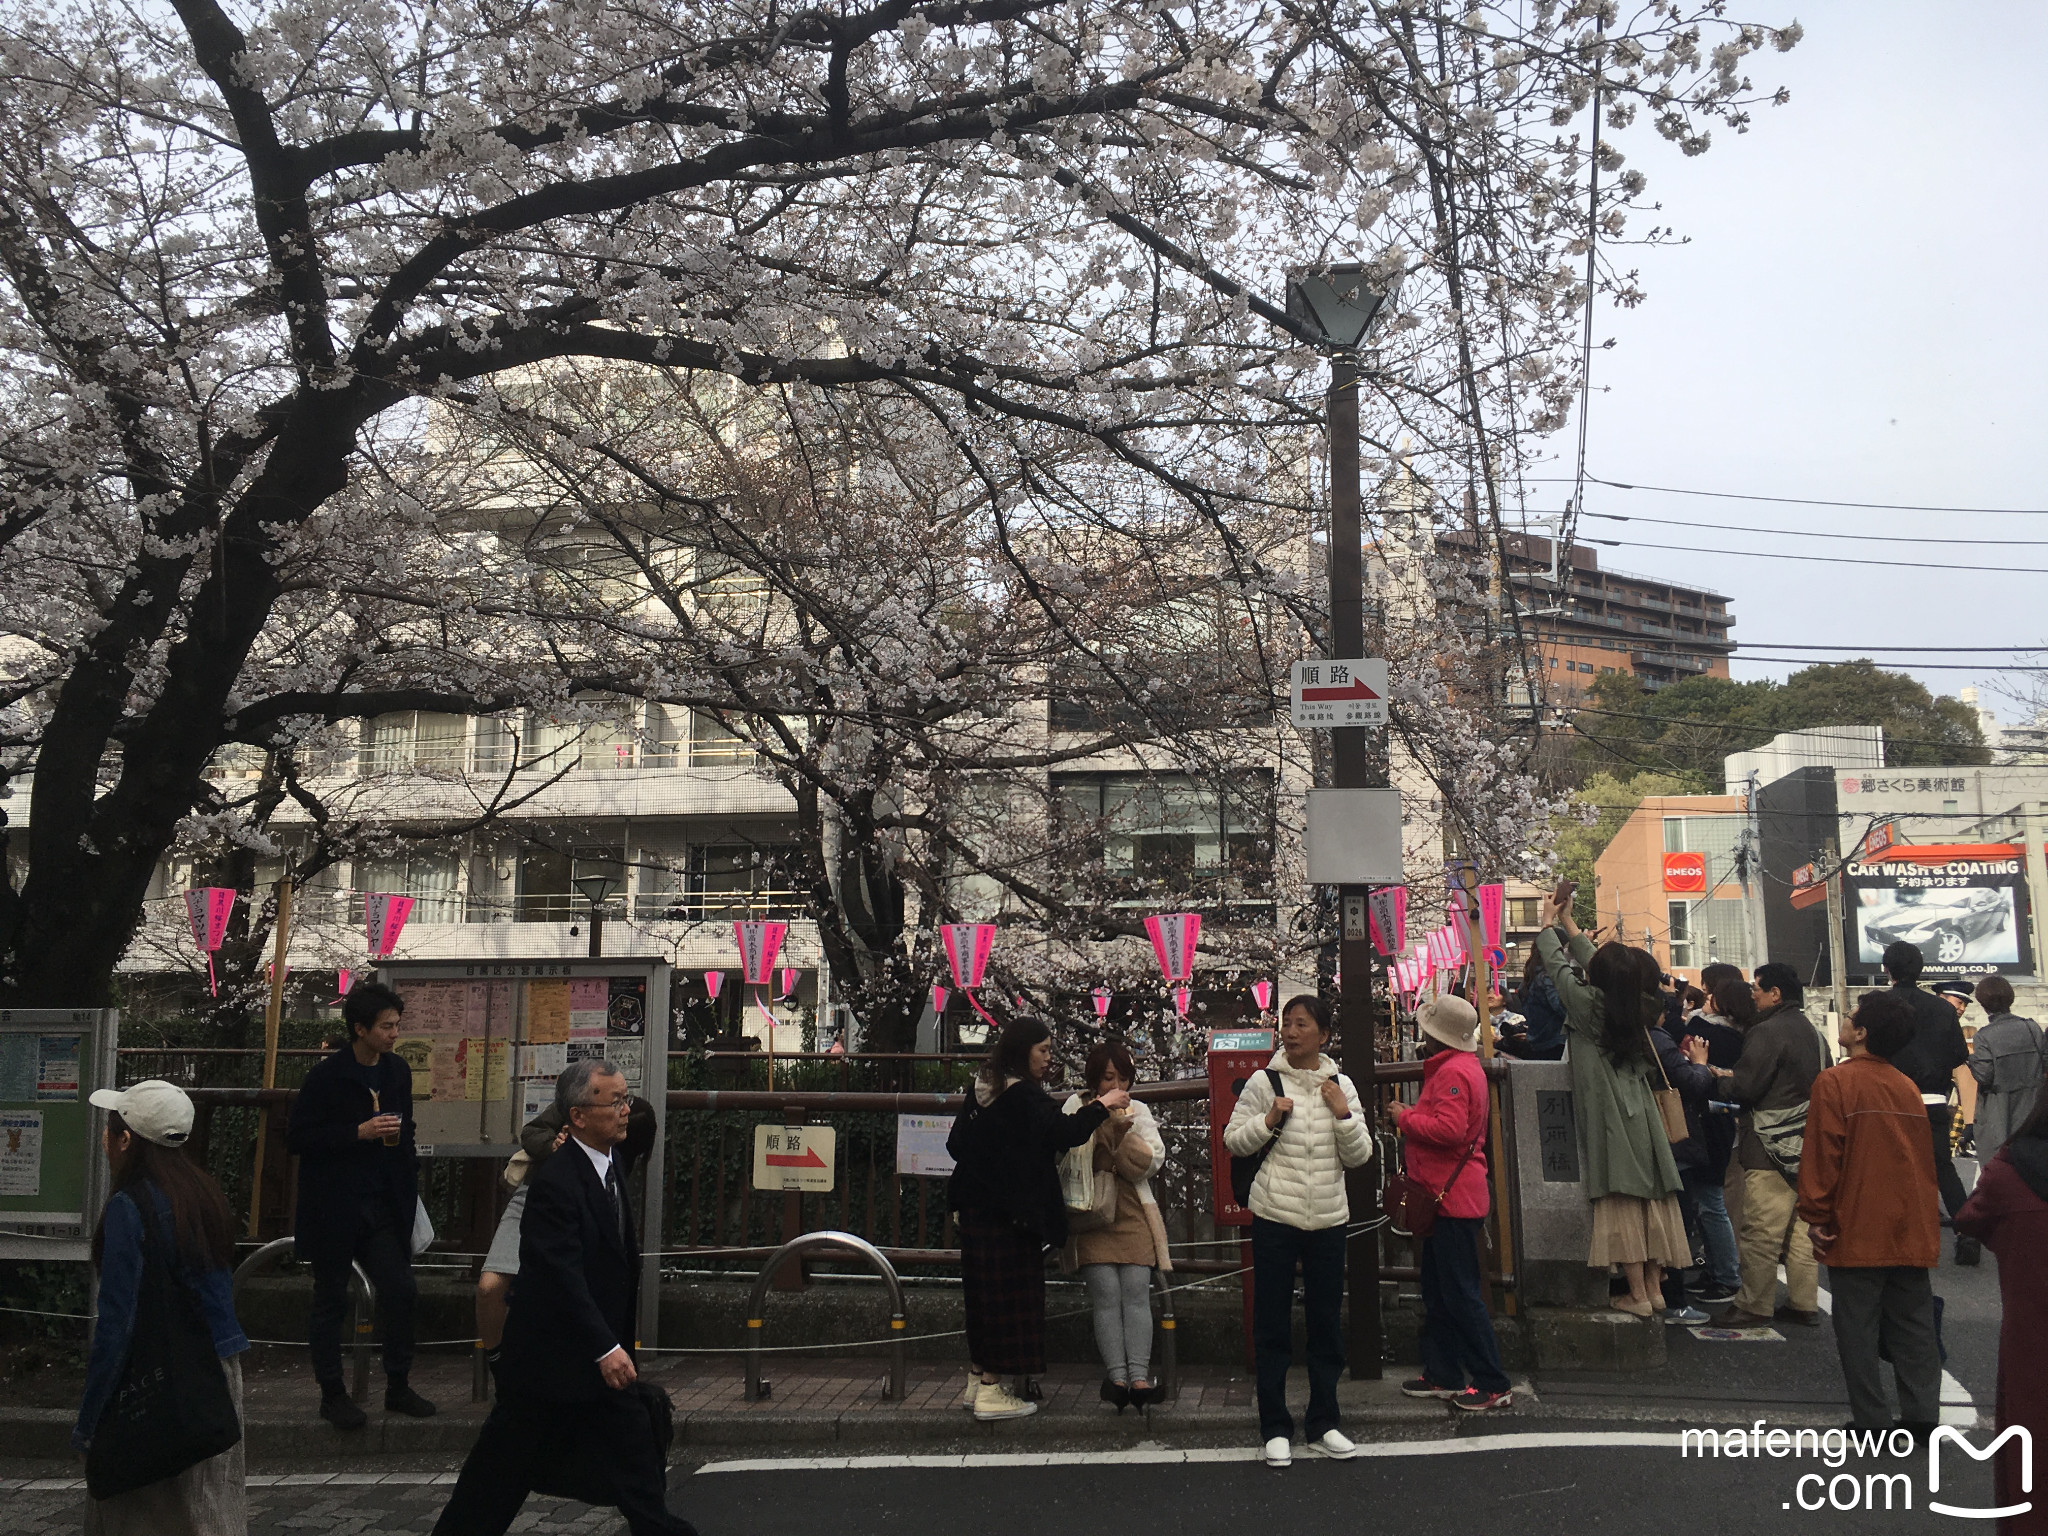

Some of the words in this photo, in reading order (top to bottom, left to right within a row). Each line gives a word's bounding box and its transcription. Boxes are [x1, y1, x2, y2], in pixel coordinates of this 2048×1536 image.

[1300, 665, 1350, 685] 順路
[1300, 703, 1315, 711] This
[1317, 703, 1333, 711] Way
[1861, 777, 1966, 793] 郷さくら美術館
[1868, 827, 1887, 852] ENEOS
[1666, 867, 1703, 876] ENEOS
[1795, 866, 1809, 886] ENEOS
[1846, 862, 1880, 876] CAR
[1882, 862, 1932, 876] WASH
[1896, 877, 1970, 887] 予約承ります
[212, 891, 225, 945] 目黒川桜まつり
[384, 900, 405, 952] 目黒川桜まつり
[1351, 918, 1357, 926] K
[466, 966, 571, 976] 目黒区公営掲示板
[765, 1134, 801, 1151] 順路
[1542, 1097, 1571, 1172] 別所橋
